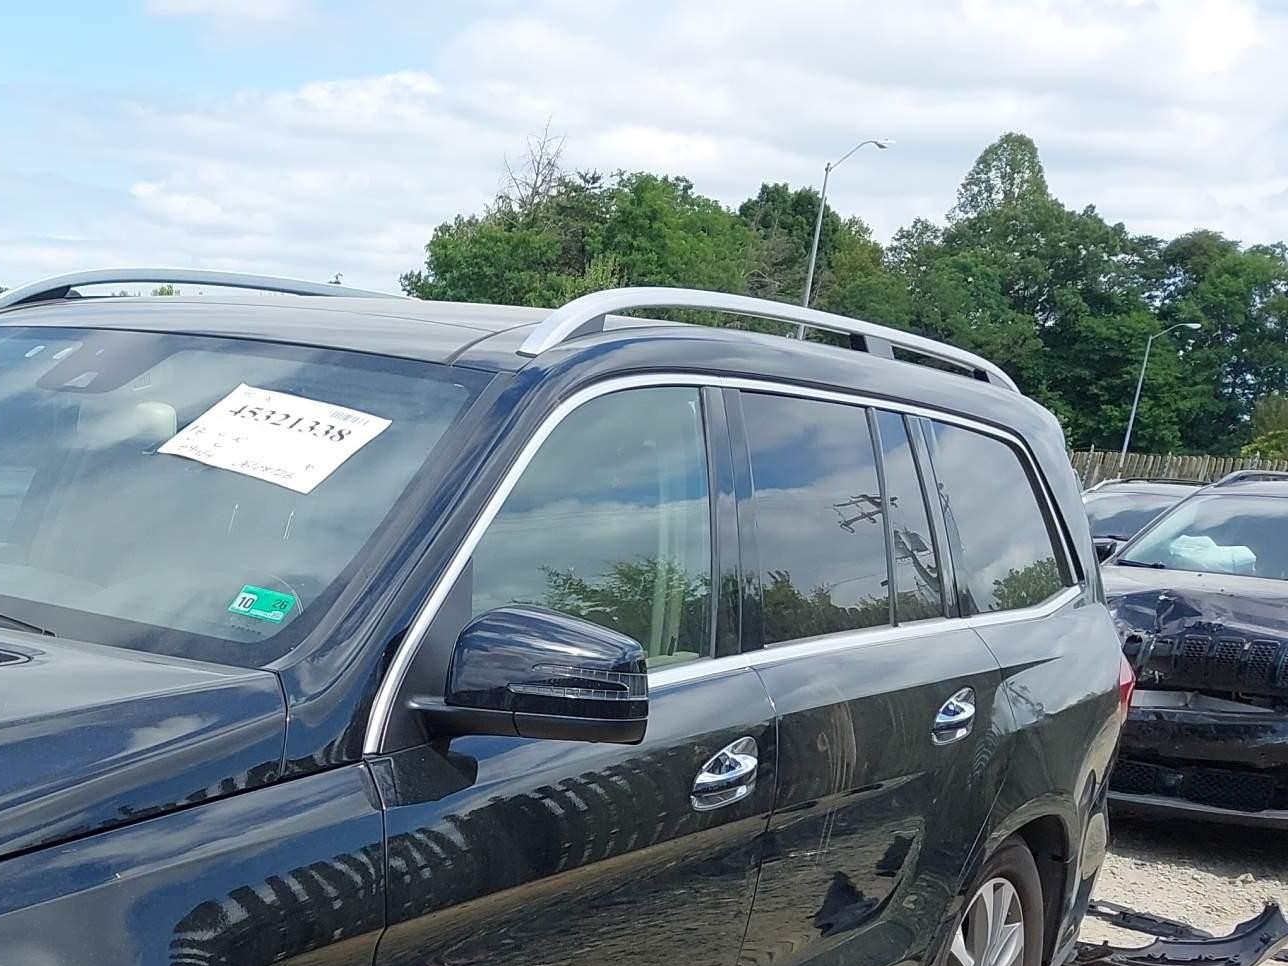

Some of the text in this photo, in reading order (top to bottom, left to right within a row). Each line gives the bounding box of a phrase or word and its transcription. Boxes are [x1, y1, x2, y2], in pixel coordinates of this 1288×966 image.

[229, 404, 352, 442] 45321338
[238, 596, 289, 610] 10 26
